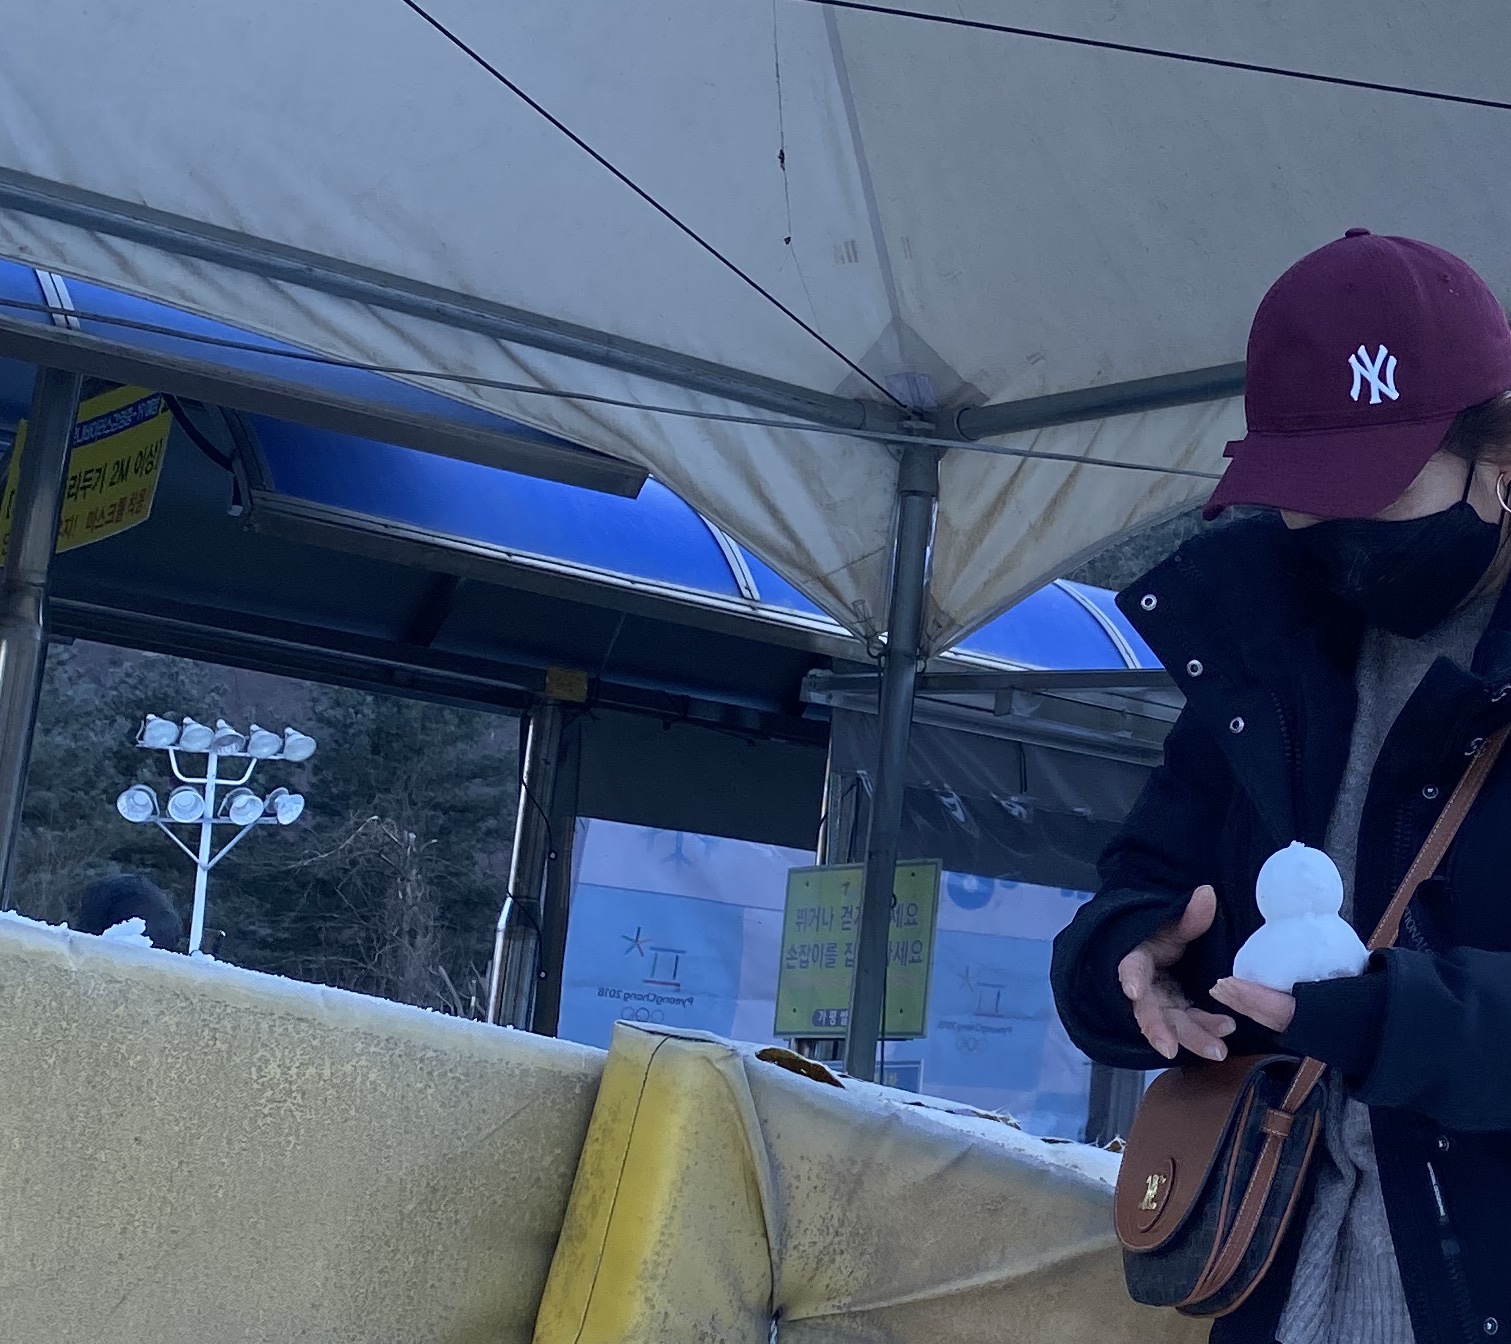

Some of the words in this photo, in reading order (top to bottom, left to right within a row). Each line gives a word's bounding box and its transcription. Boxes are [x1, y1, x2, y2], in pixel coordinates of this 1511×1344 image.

[1348, 344, 1400, 405] NY
[67, 463, 108, 501] 리두기
[109, 456, 131, 488] 2M
[795, 906, 835, 932] 뛰거나
[891, 903, 918, 928] 세요
[785, 941, 838, 970] 손잡이를
